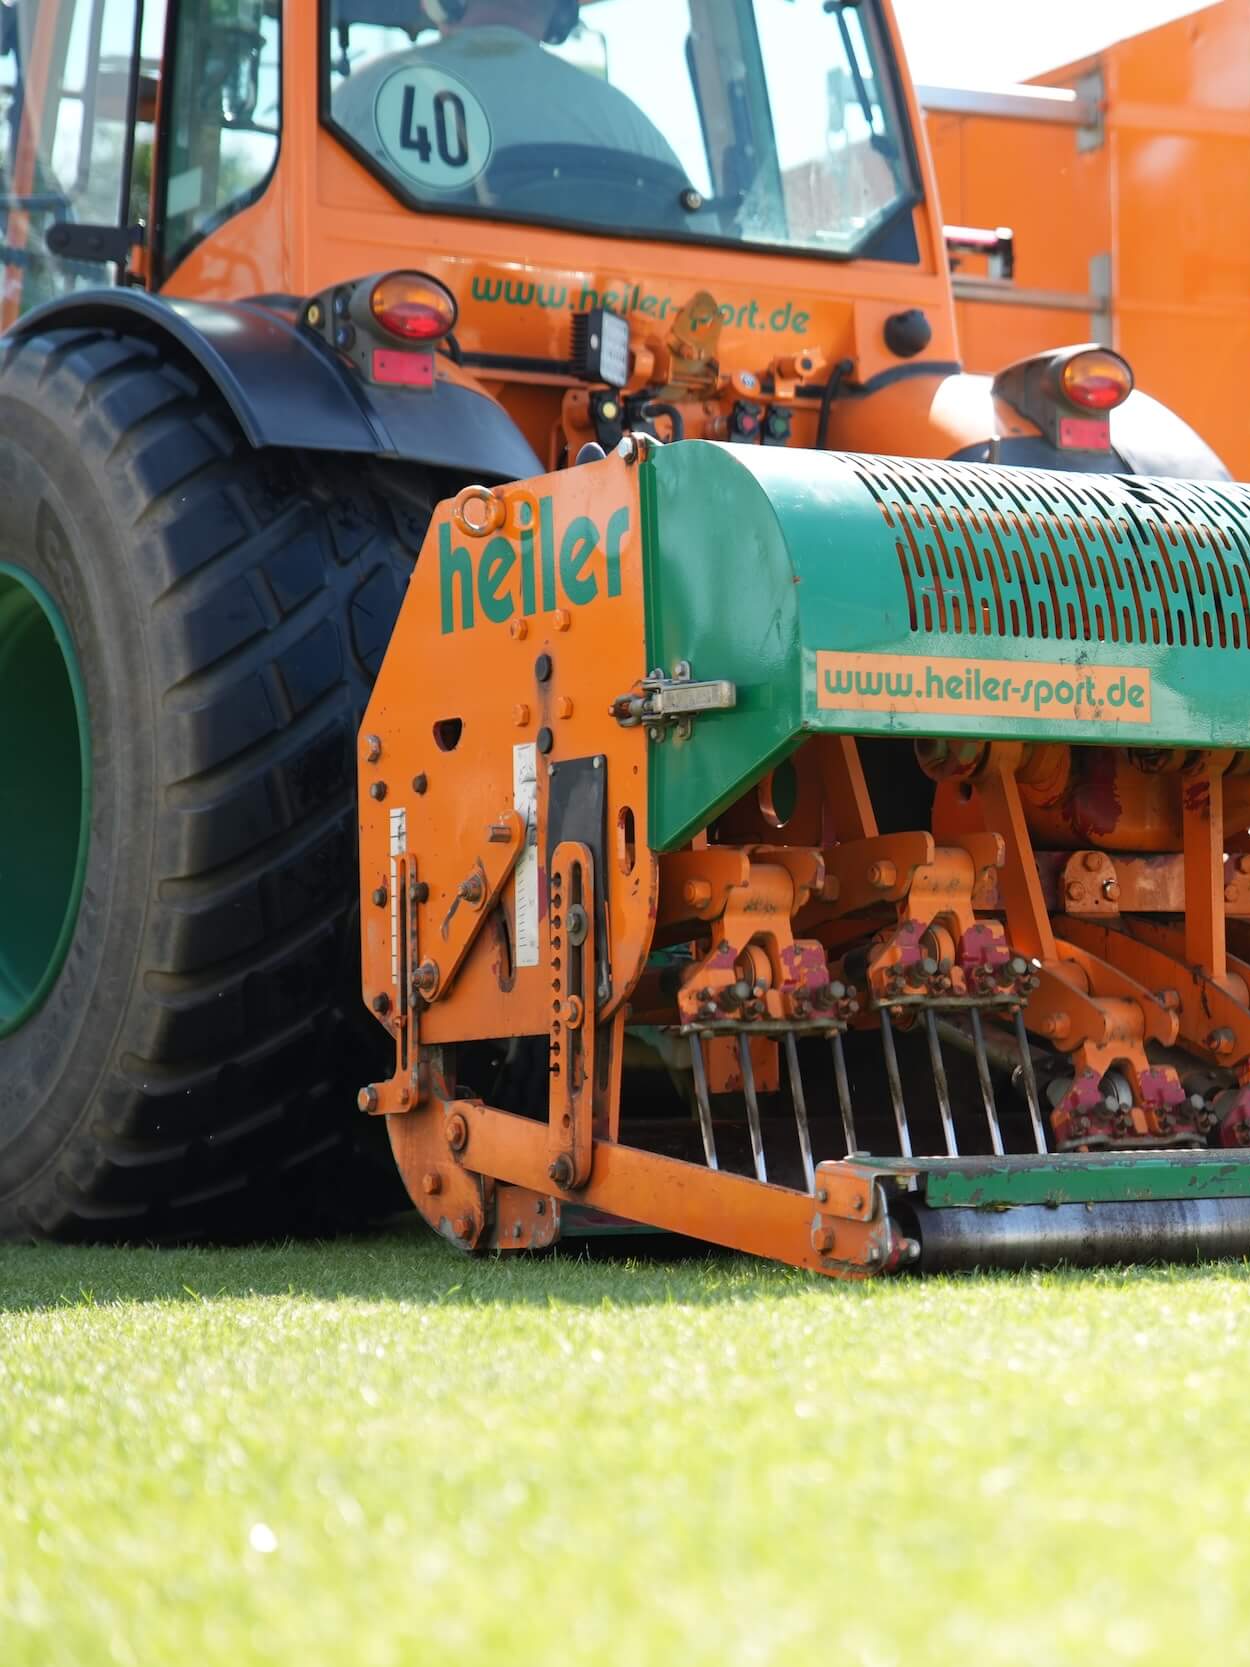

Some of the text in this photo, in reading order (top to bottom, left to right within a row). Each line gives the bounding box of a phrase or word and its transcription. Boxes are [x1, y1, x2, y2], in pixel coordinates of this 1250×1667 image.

[401, 85, 468, 168] 40
[471, 275, 811, 334] www.heiler-port.de
[439, 496, 630, 635] heiler
[824, 666, 1145, 711] www.heiler-sport.de
